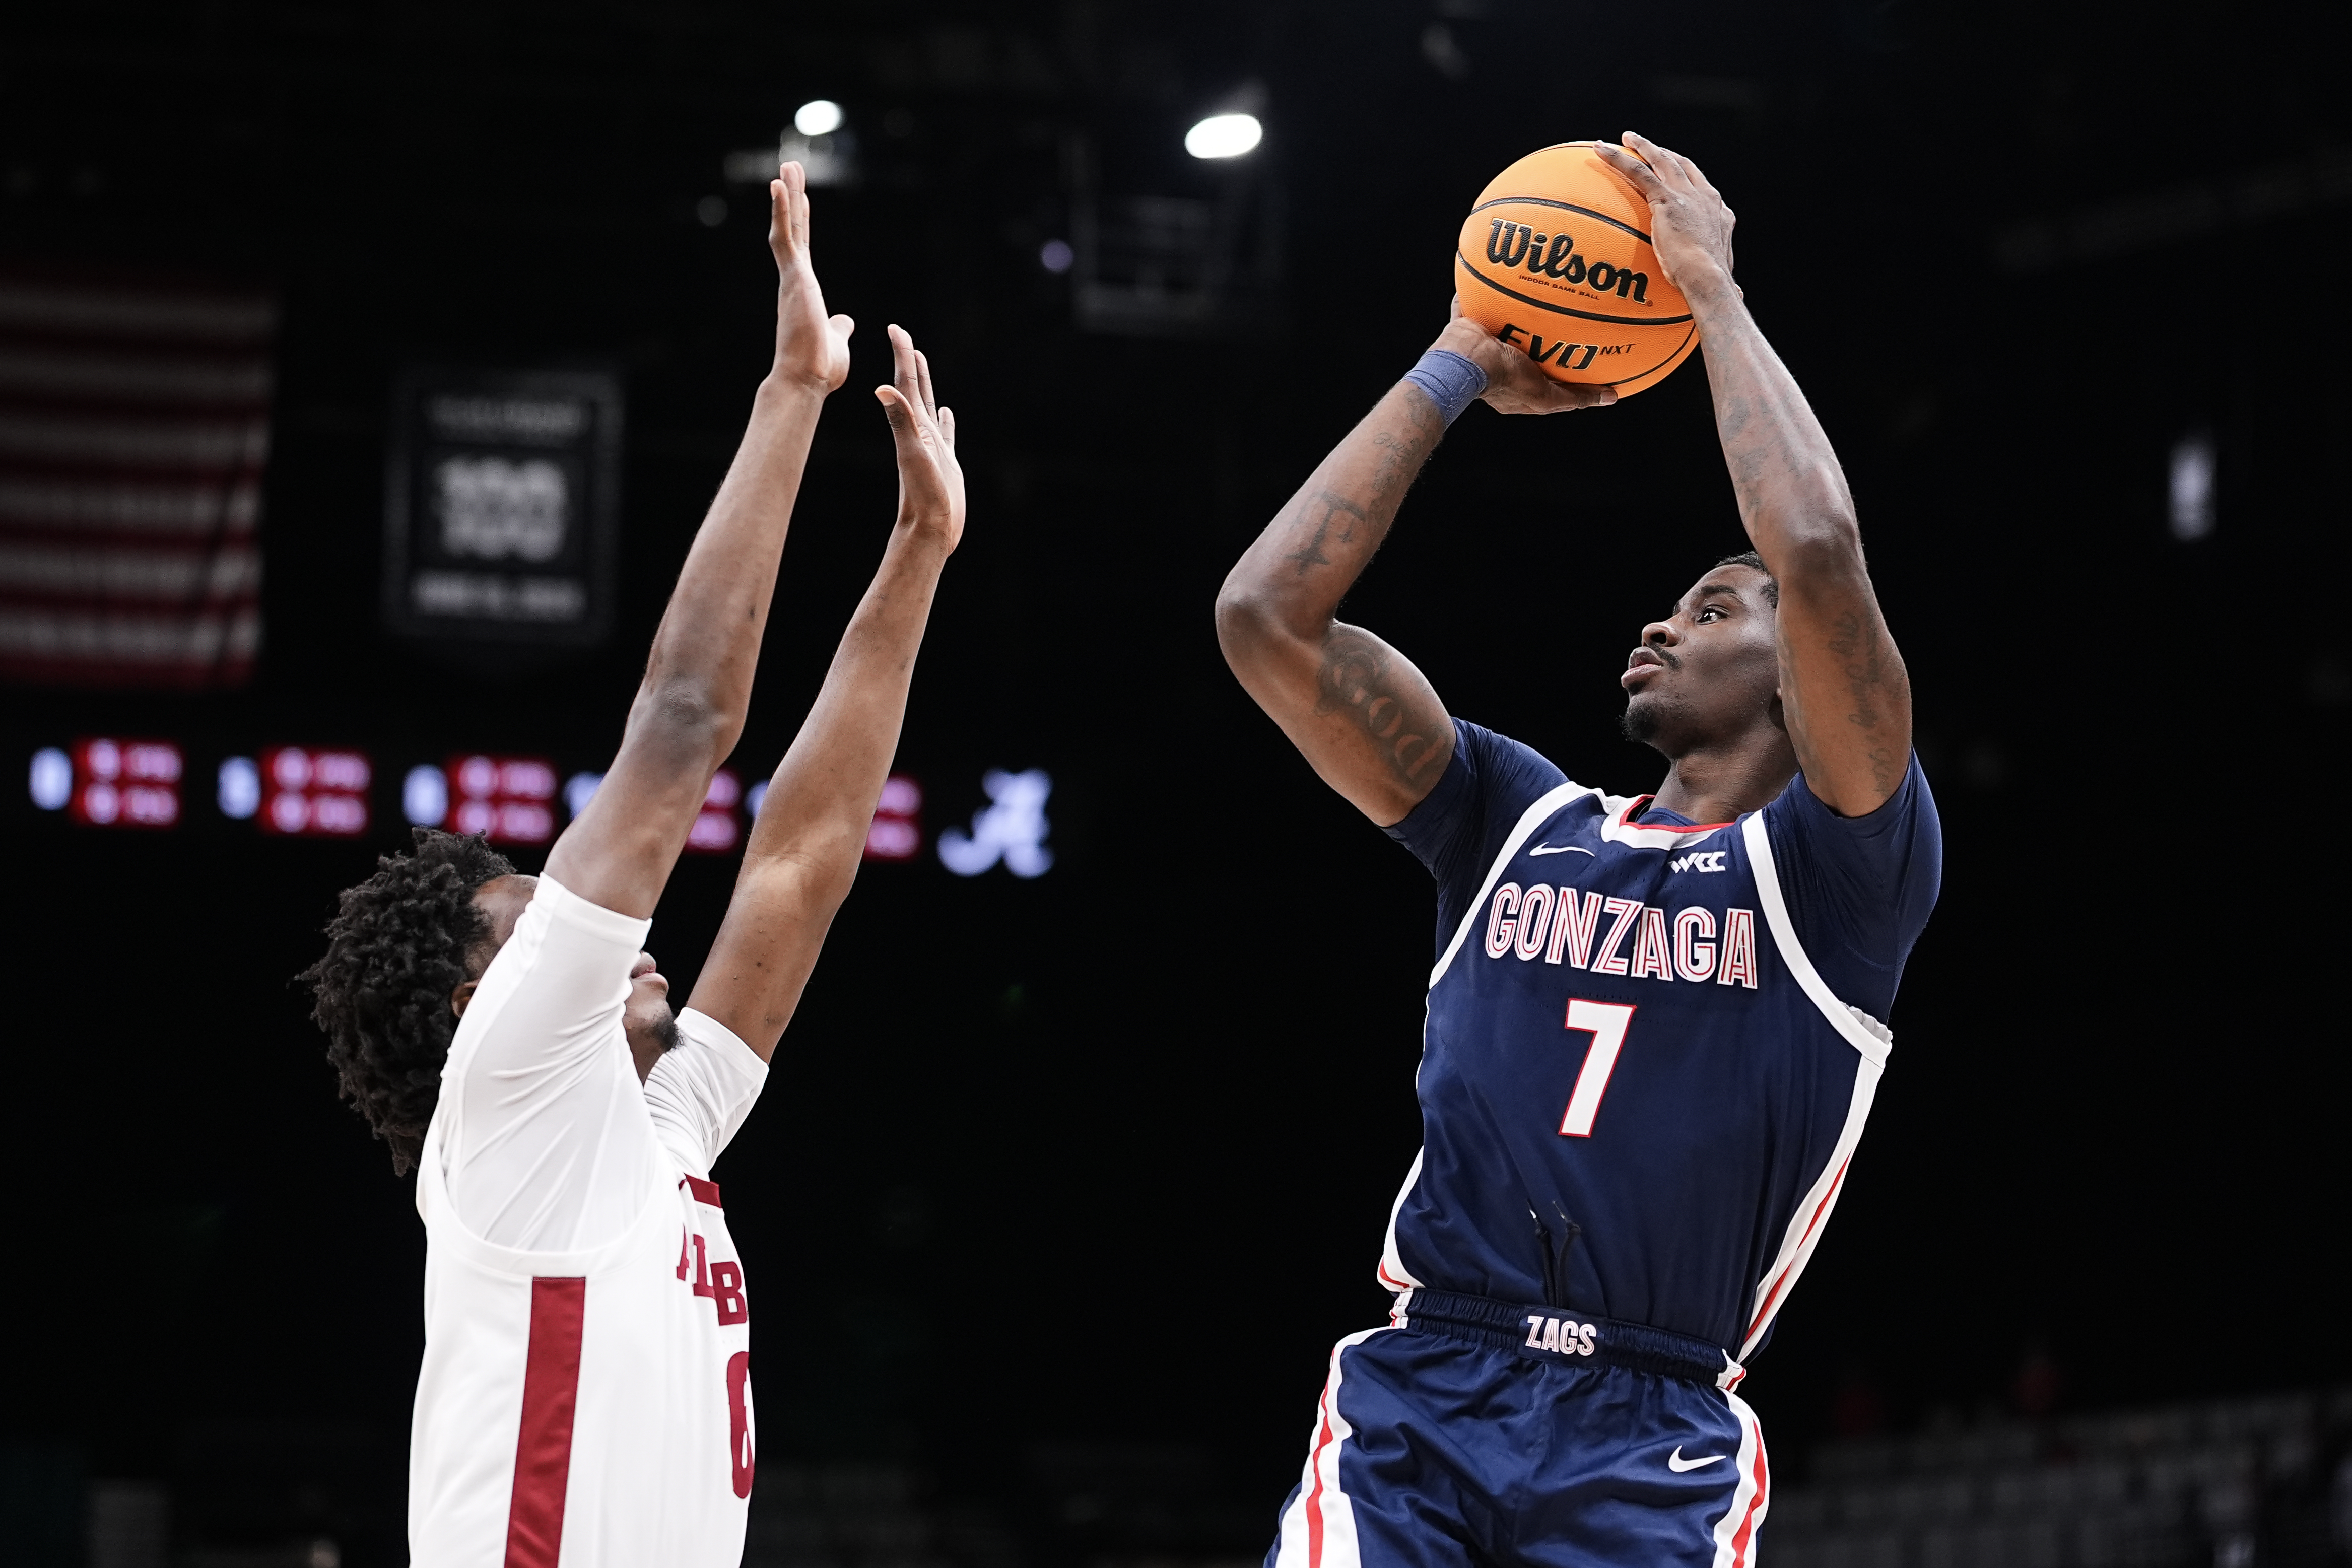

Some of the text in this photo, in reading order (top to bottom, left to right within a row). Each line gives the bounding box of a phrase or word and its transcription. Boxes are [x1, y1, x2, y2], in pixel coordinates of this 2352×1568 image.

[1486, 218, 1648, 306] Wilson
[1519, 275, 1600, 300] INDOOR GAME BALL
[1599, 343, 1636, 355] NXT
[1667, 851, 1726, 874] WCC
[1485, 881, 1758, 990] GONZAGA
[1558, 997, 1637, 1138] 7
[1525, 1315, 1597, 1357] ZAGS
